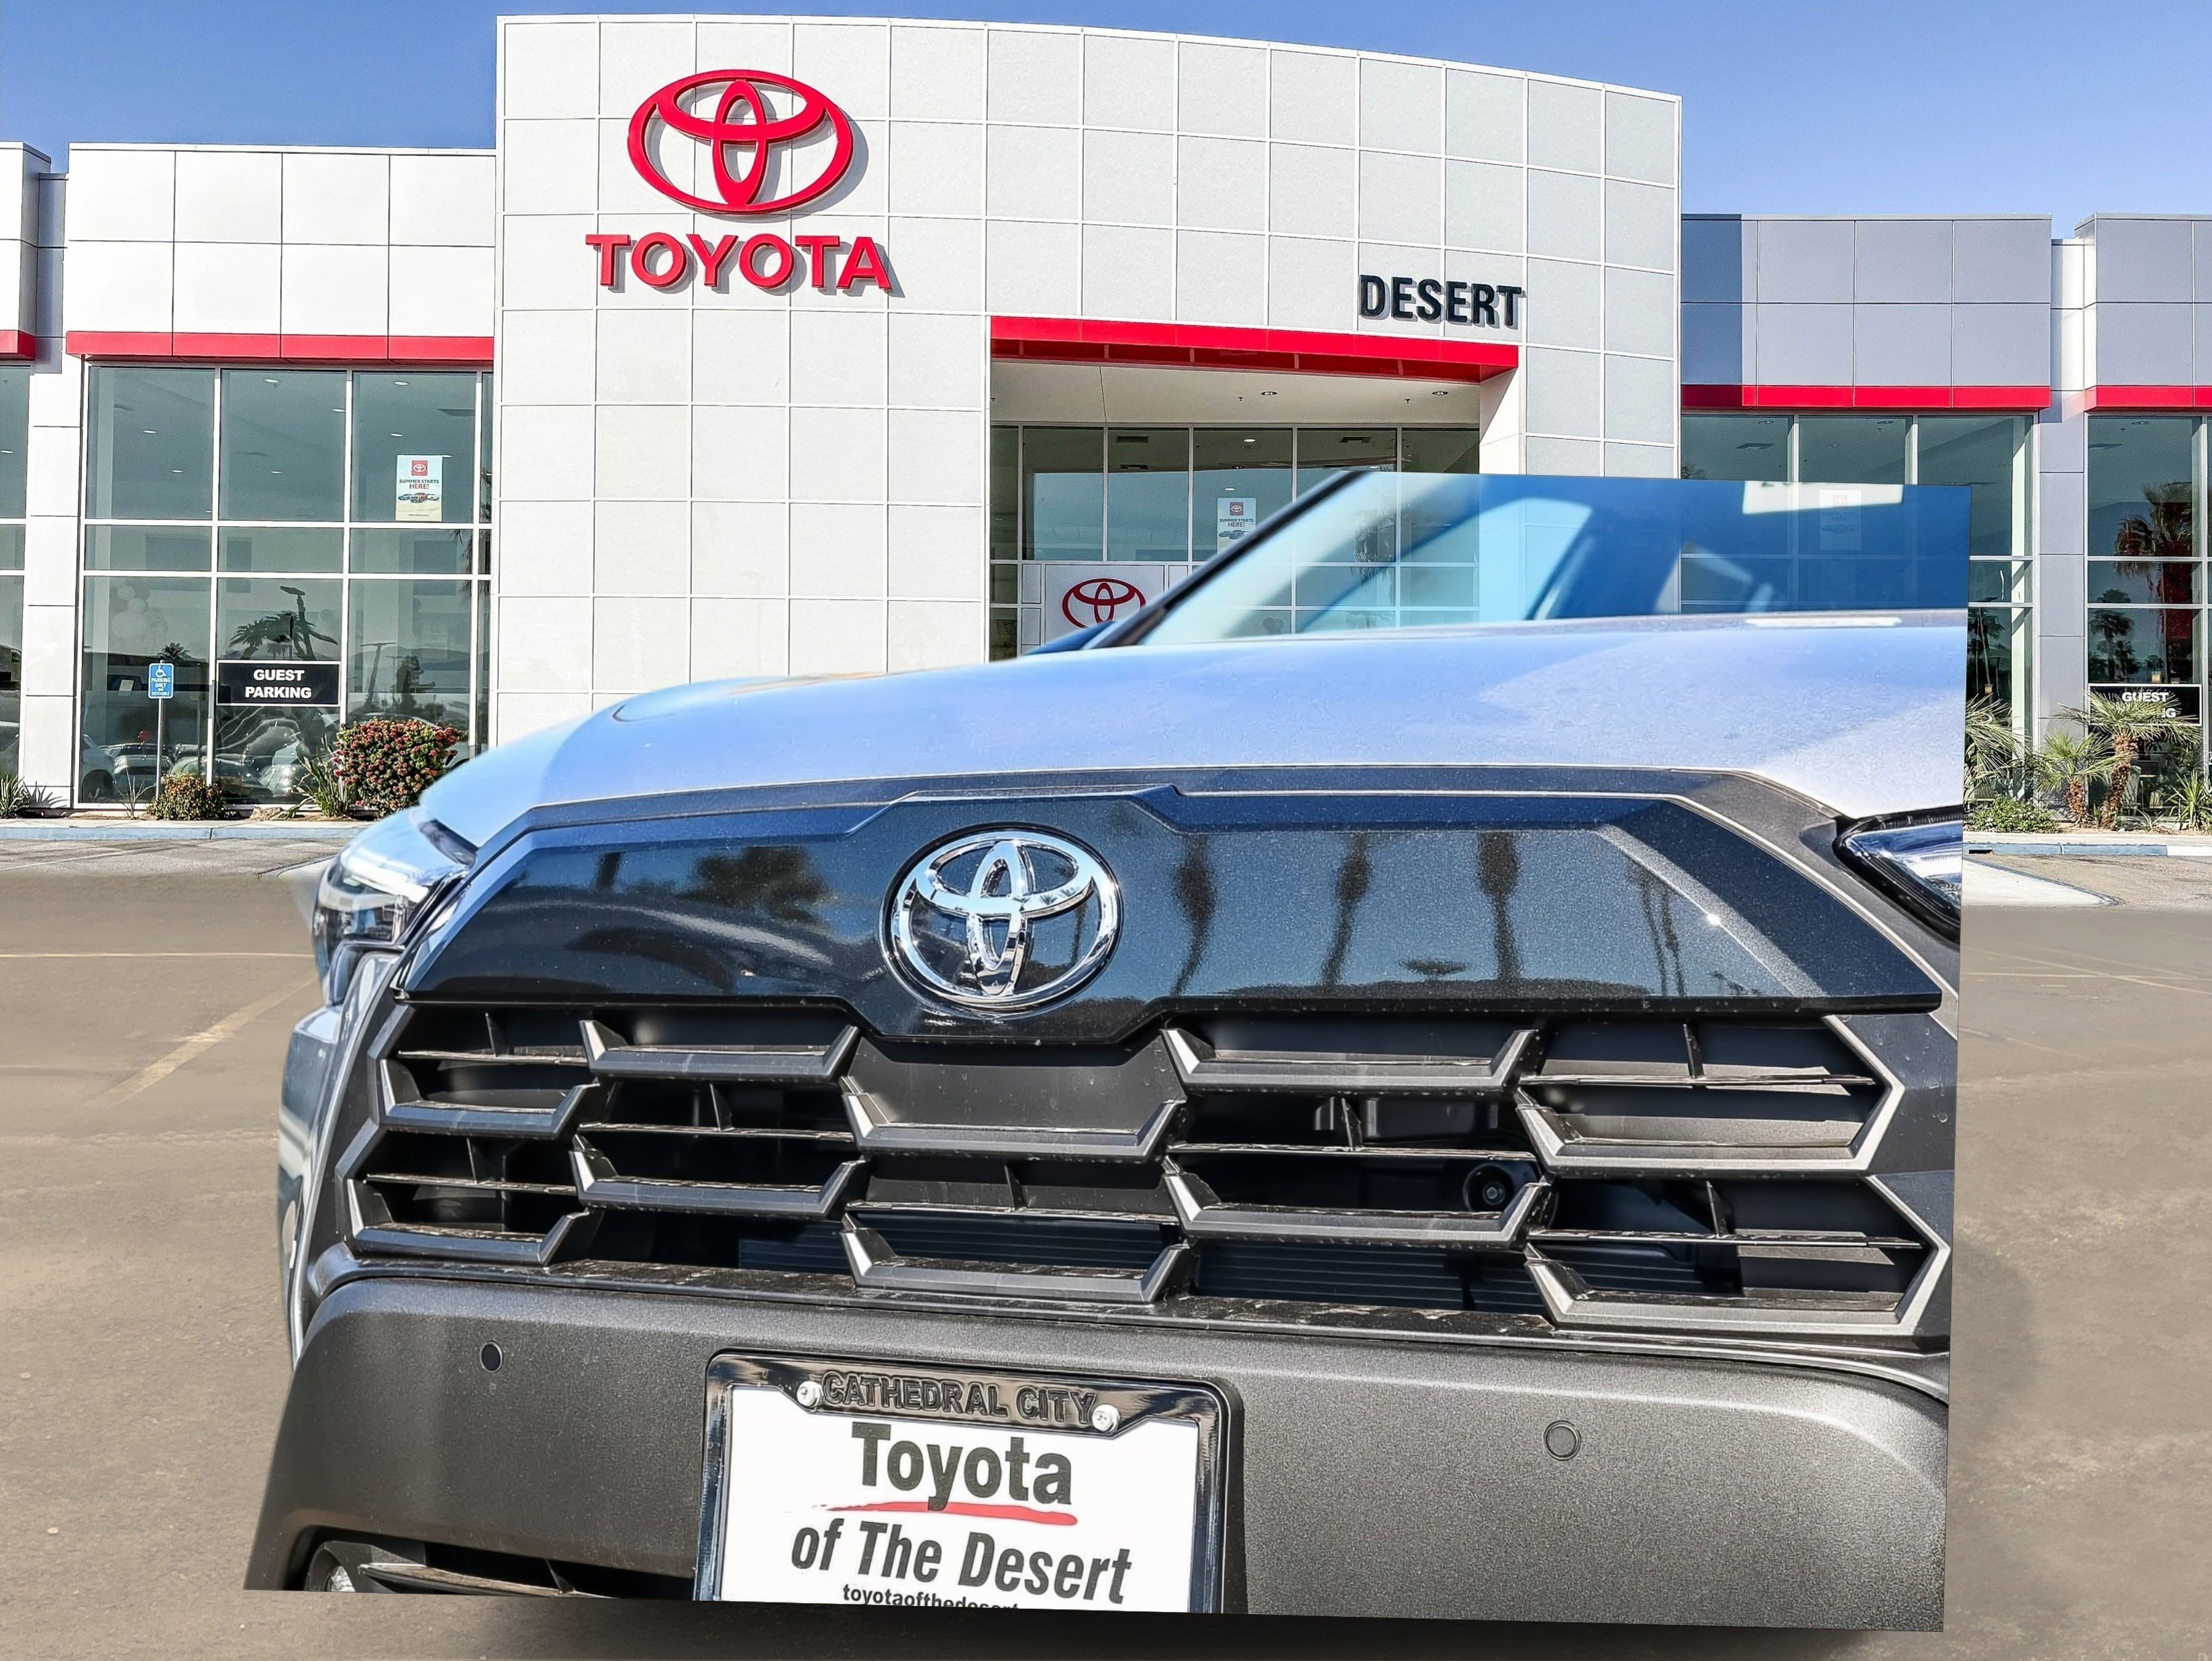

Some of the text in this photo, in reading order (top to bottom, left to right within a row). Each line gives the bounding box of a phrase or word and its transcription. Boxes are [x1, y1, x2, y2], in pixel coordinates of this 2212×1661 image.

[586, 232, 892, 290] TOYOTA
[1359, 274, 1522, 327] DESERT
[245, 687, 312, 699] PARKING
[253, 669, 305, 681] GUEST
[2121, 692, 2169, 702] GUEST
[822, 1370, 1097, 1425] CATHEDRAL CITY
[852, 1421, 1072, 1511] Toyota
[791, 1518, 1132, 1604] of The Desert
